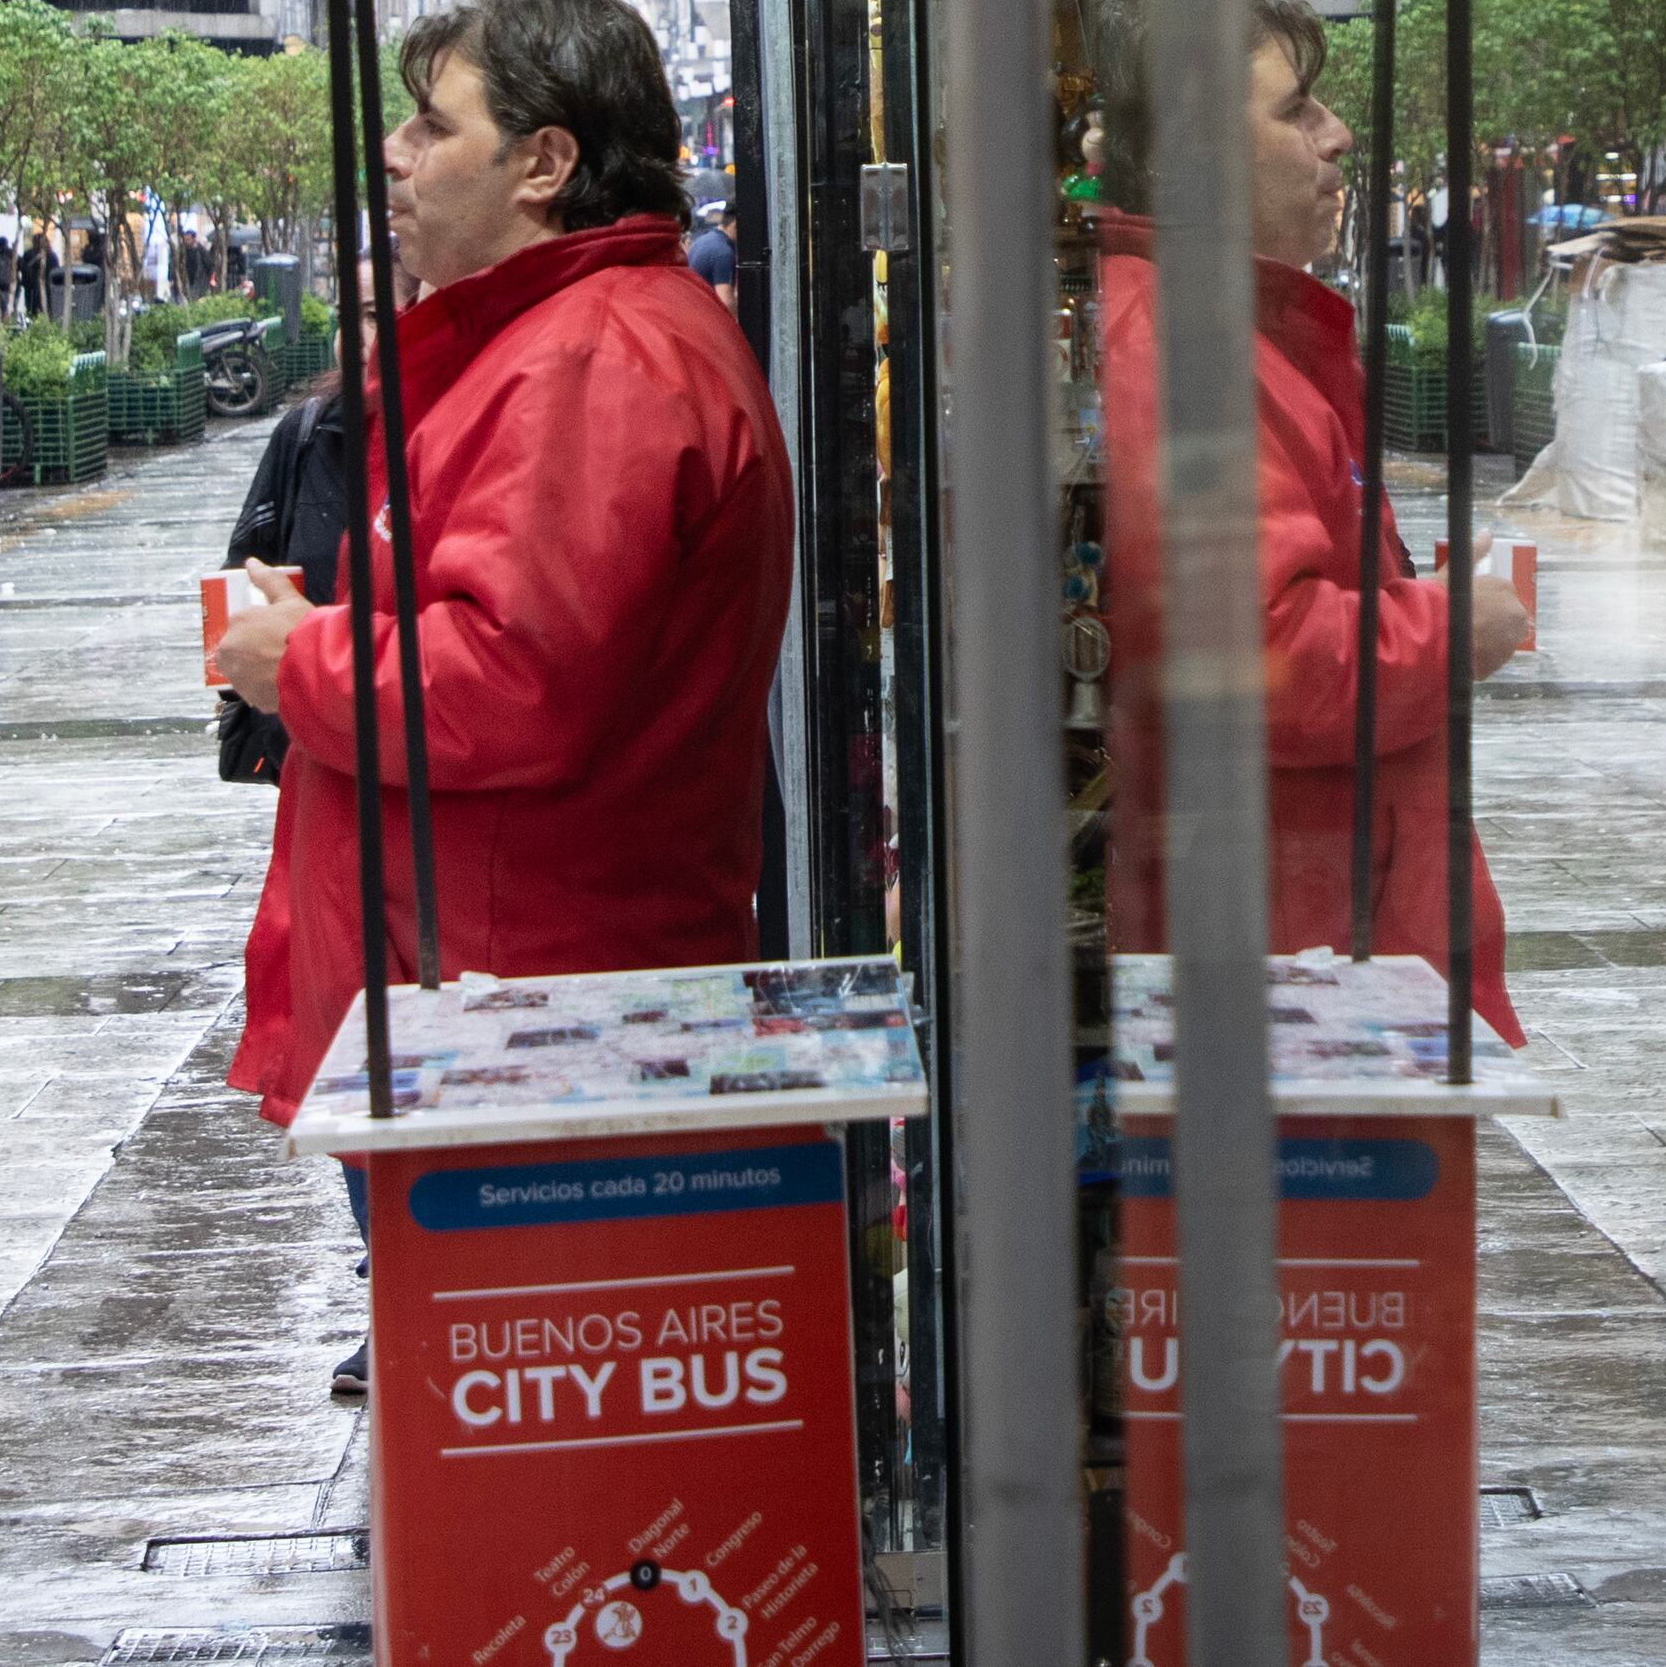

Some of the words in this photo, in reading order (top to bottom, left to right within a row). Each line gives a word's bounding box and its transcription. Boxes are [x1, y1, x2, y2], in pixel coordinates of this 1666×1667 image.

[479, 1182, 584, 1208] Servicios
[589, 1175, 647, 1199] cada
[652, 1170, 685, 1195] 20
[691, 1166, 782, 1191] minutos
[449, 1310, 643, 1364] BUENOS
[658, 1298, 784, 1348] AIRES
[451, 1359, 617, 1429] CITY
[641, 1347, 788, 1413] BUS
[629, 1497, 684, 1553] Diagonal
[653, 1524, 690, 1557] Norte
[706, 1511, 762, 1567] Congreso
[534, 1546, 575, 1583] Teatro
[741, 1574, 779, 1609] Paseo
[778, 1557, 795, 1575] de
[583, 1588, 605, 1604] 24
[761, 1562, 819, 1619] Historieta
[471, 1614, 527, 1665] Recoleta
[552, 1630, 572, 1645] 23
[727, 1615, 738, 1630] 2
[778, 1616, 818, 1654] Telmo
